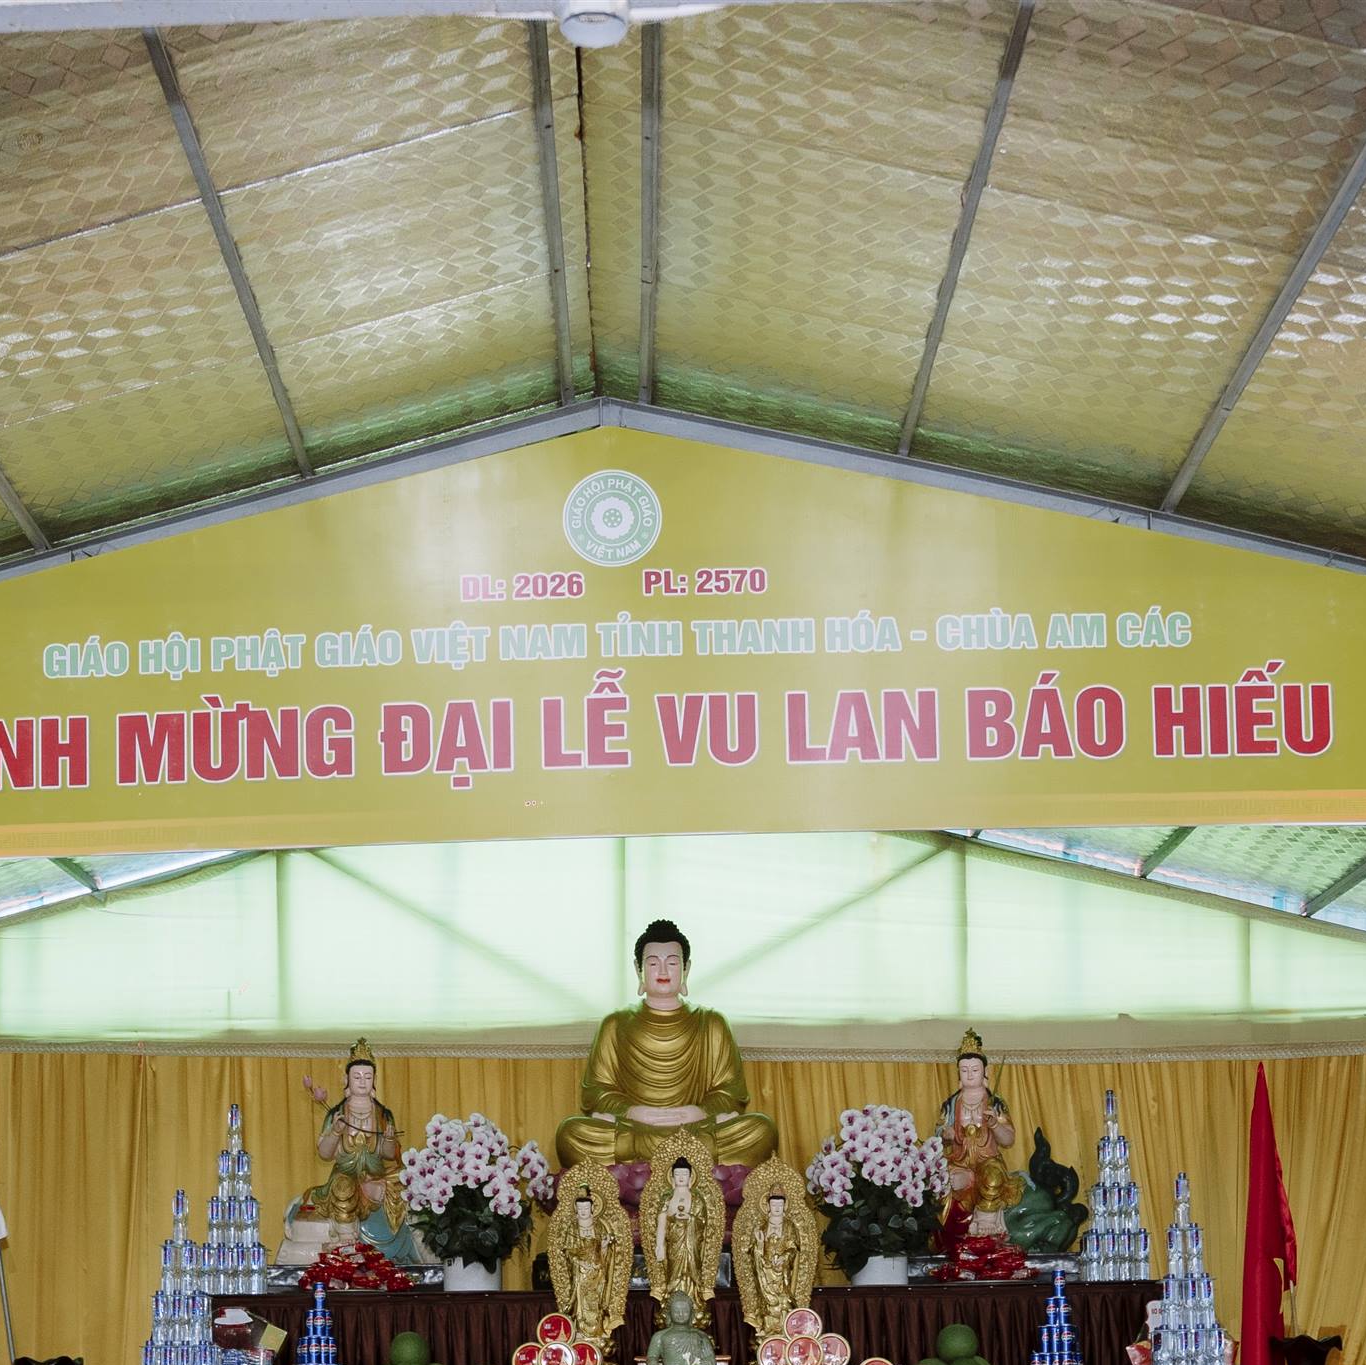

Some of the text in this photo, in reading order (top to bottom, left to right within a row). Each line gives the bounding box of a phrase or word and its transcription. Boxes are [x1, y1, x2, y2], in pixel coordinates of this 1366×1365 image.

[571, 478, 655, 529] GIÁO HỘI PHẬT GIÁO
[586, 540, 642, 559] VIỆT NAM
[460, 568, 766, 601] DL: 2026 PL: 2570
[44, 636, 129, 679] GIÁO
[139, 631, 200, 680] HỘI
[211, 629, 306, 677] PHẬT
[315, 624, 402, 668] GIÁO
[411, 620, 491, 670] VIỆT
[499, 623, 587, 661] NAM
[596, 611, 682, 657] TỈNH
[691, 618, 816, 656] THANH
[825, 610, 901, 653] HÓA
[936, 607, 1038, 651] CHÙA
[1046, 613, 1107, 649] AM
[1117, 606, 1192, 648] CÁC
[116, 695, 354, 784] MỪNG
[379, 699, 514, 790] ĐẠI
[541, 668, 631, 769] LỄ
[655, 693, 758, 766] VU
[785, 689, 939, 763] LAN
[965, 671, 1127, 760] BÁO
[1152, 660, 1333, 758] HIẾU
